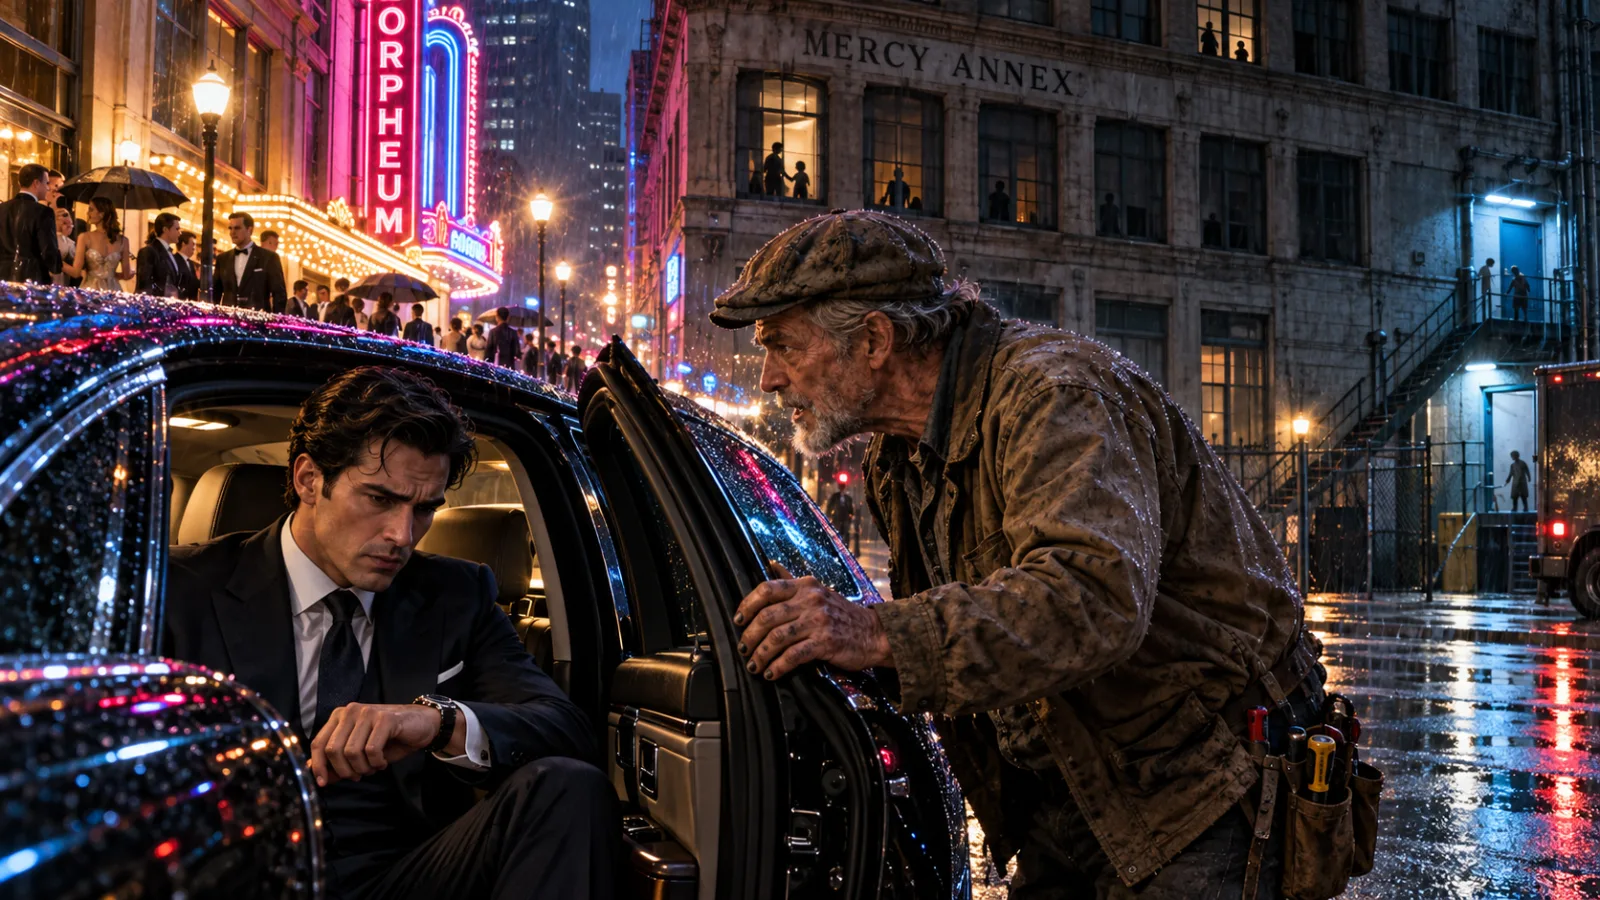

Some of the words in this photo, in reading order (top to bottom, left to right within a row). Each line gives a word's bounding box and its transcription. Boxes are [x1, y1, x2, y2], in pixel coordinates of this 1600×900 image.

[375, 6, 406, 235] ORPHEUM
[803, 29, 930, 71] MERCY
[952, 53, 1075, 97] ANNEX
